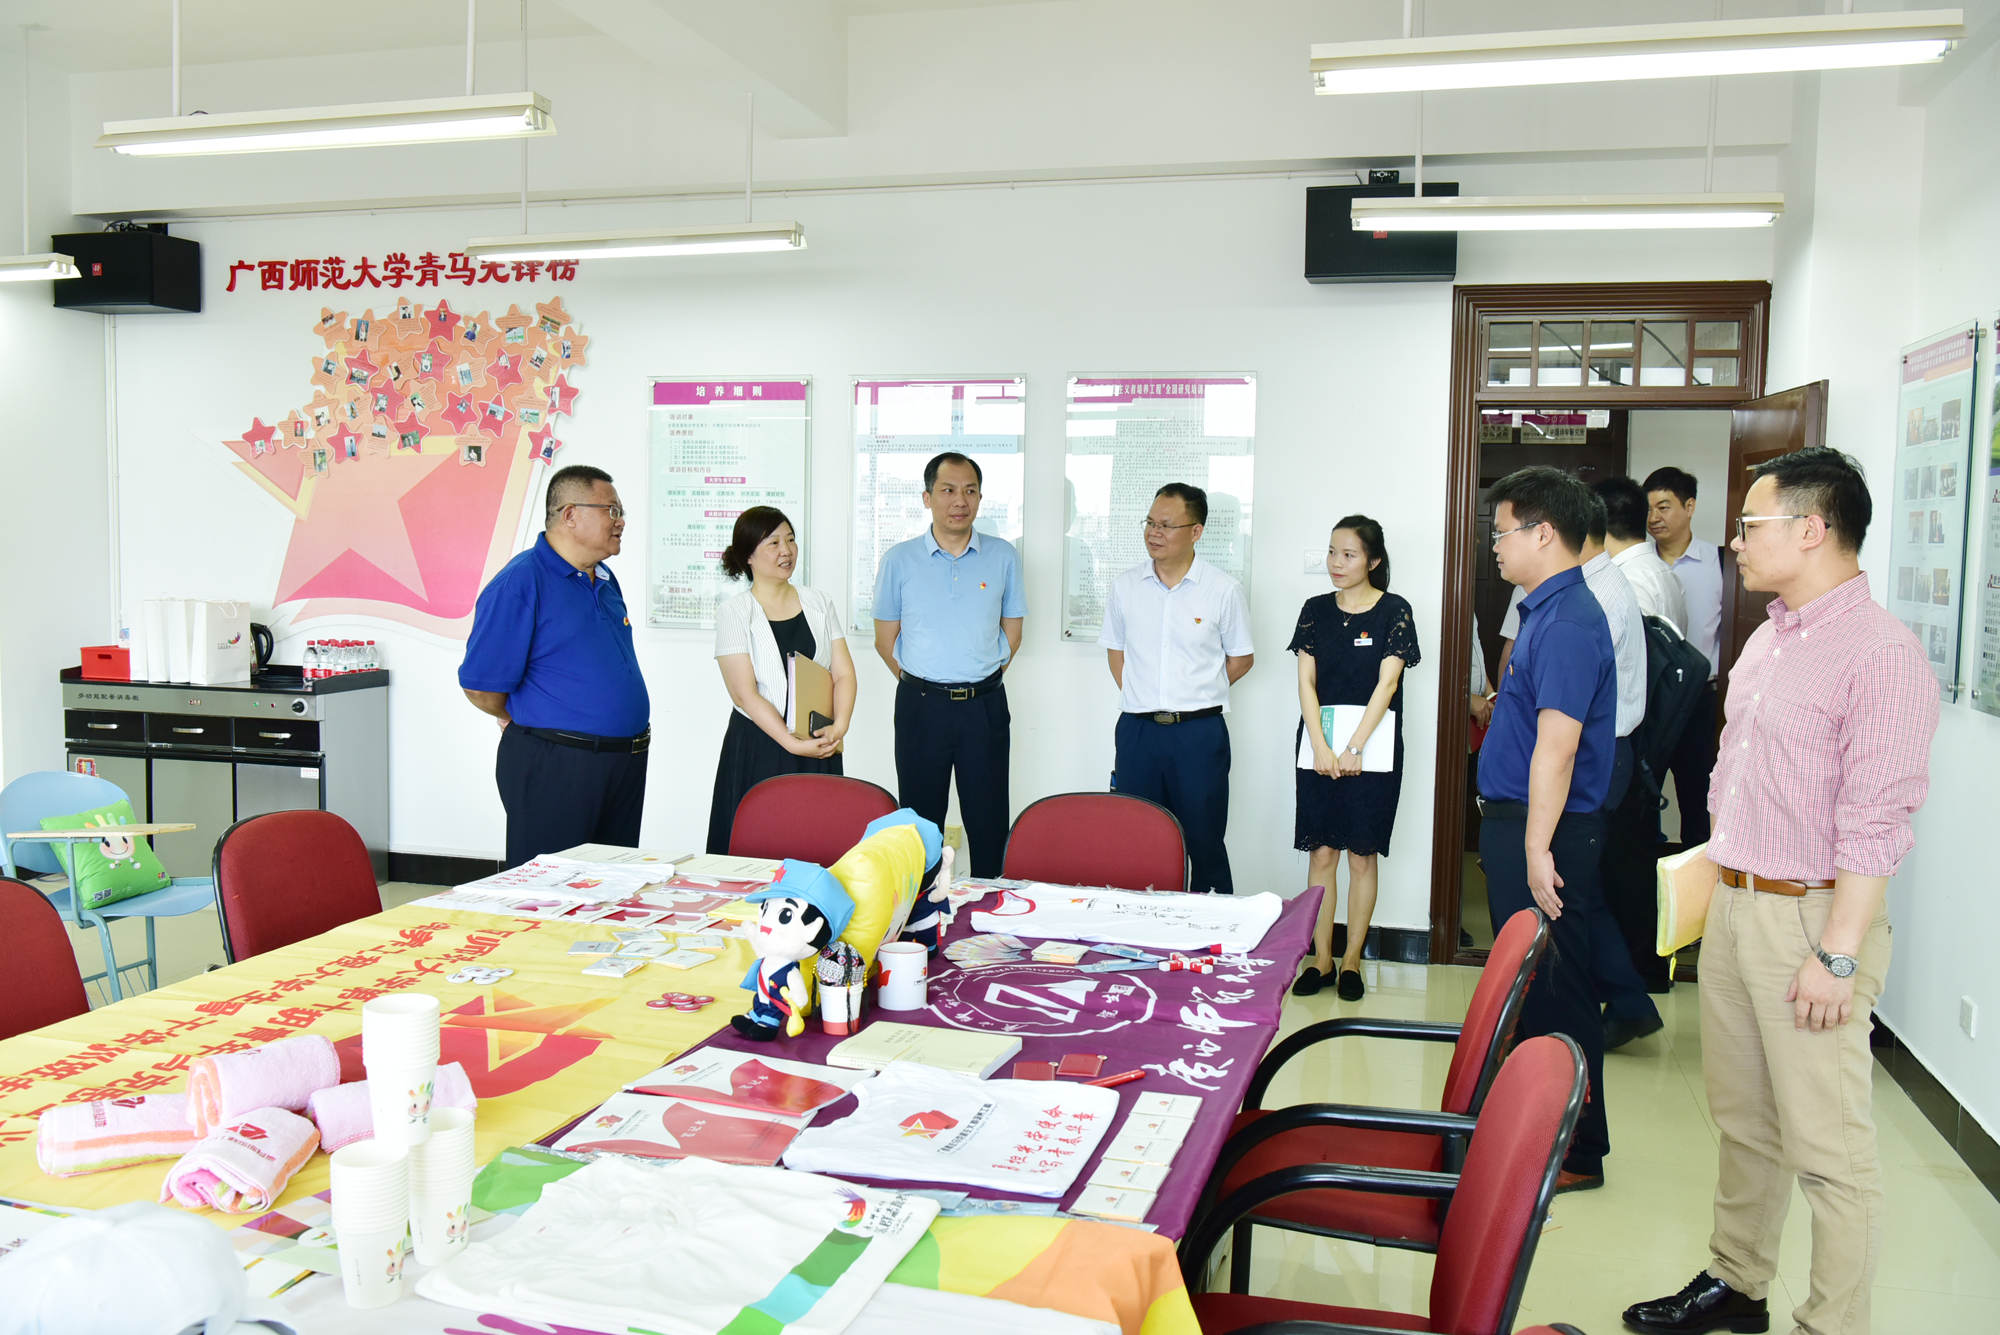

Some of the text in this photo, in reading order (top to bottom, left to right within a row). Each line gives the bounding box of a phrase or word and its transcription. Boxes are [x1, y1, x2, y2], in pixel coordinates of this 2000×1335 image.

[695, 385, 763, 397] 培养细则
[669, 429, 694, 437] 培养原则
